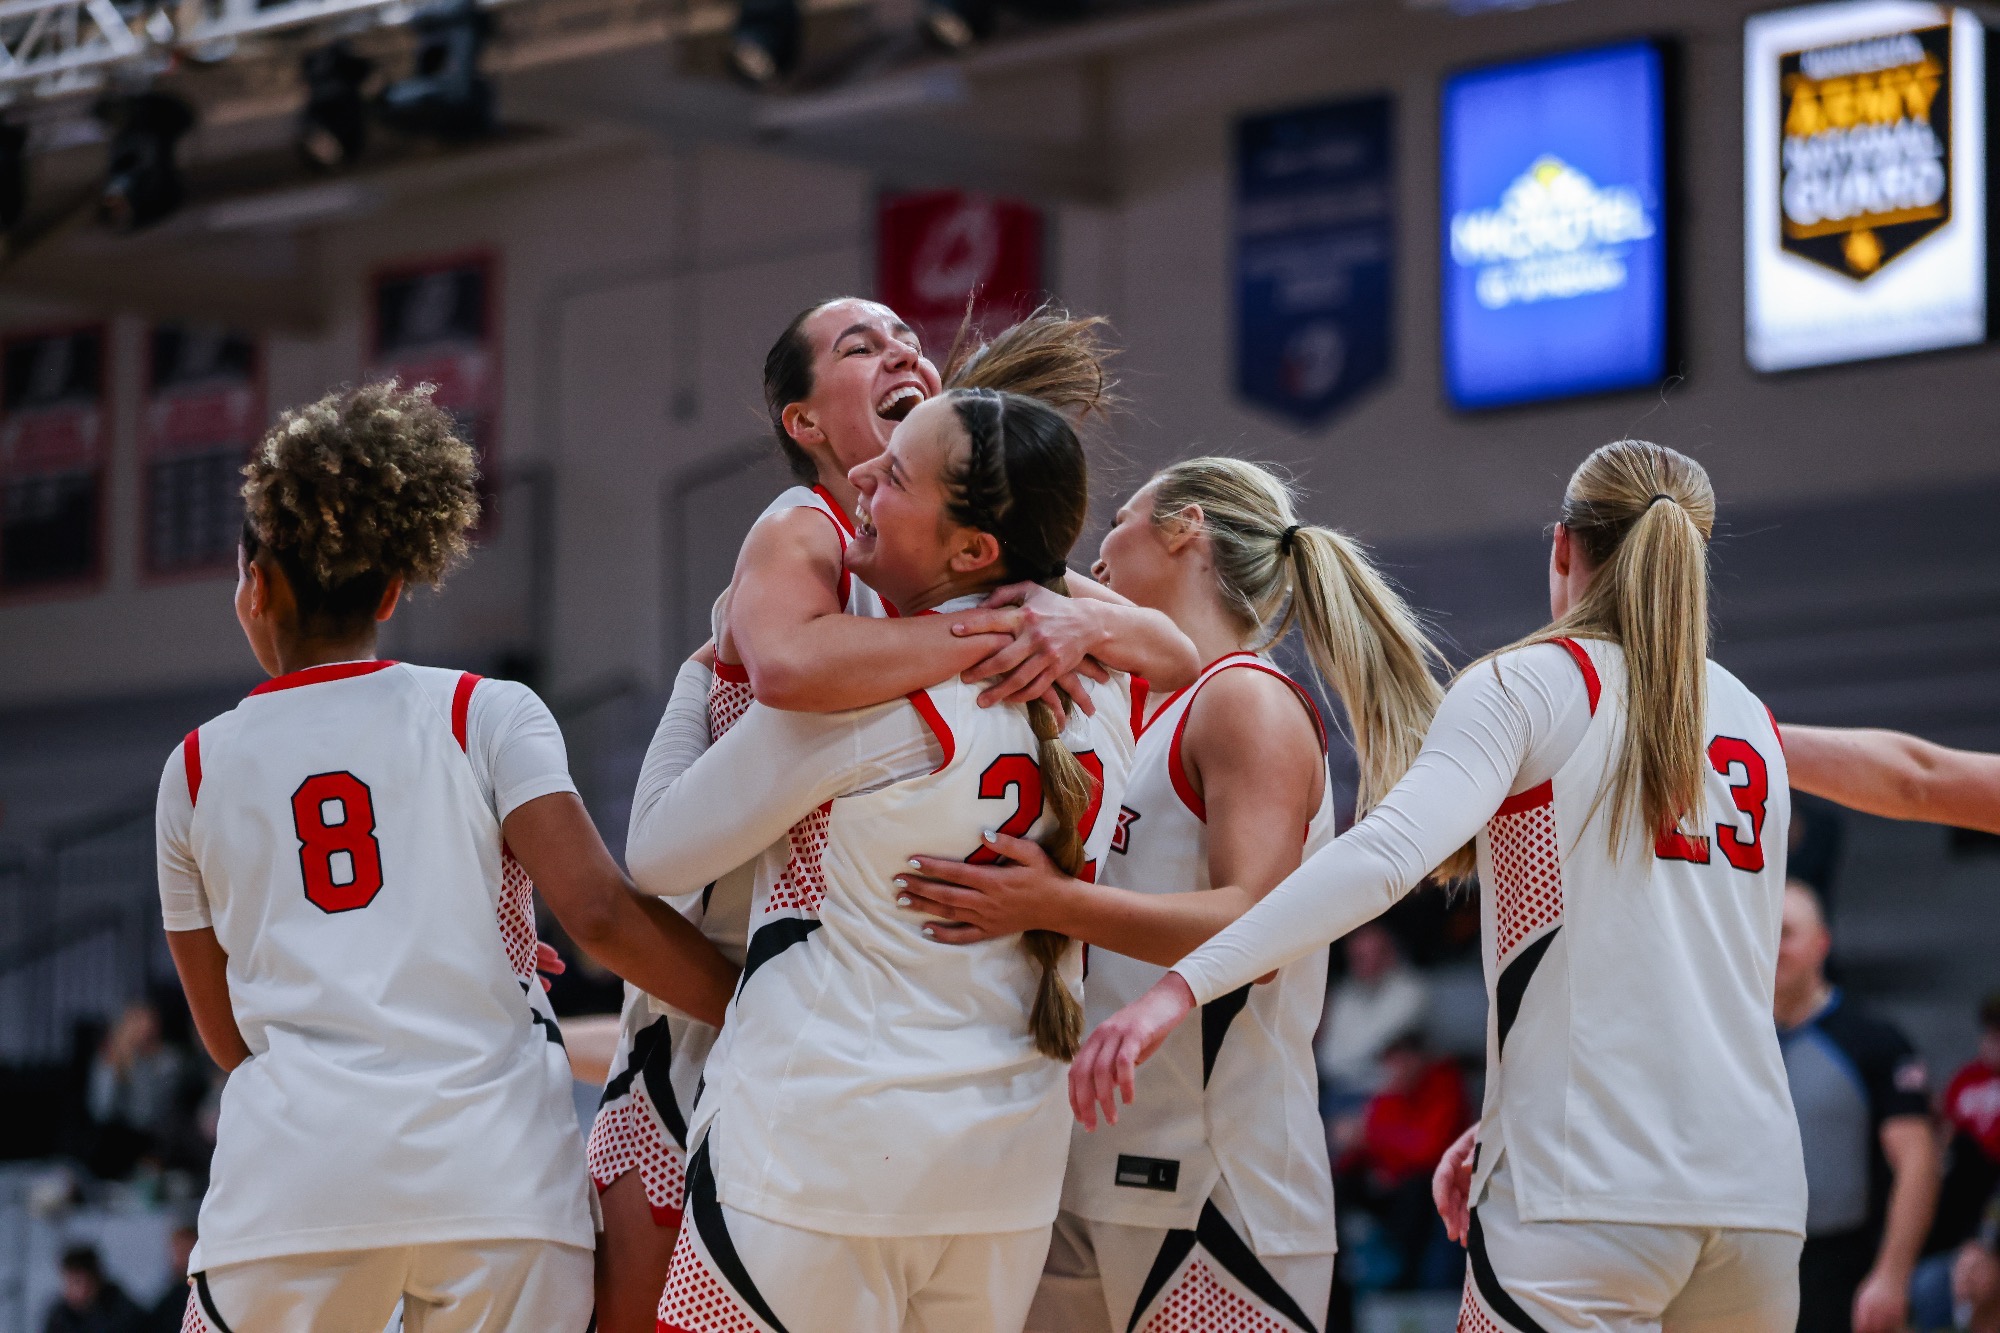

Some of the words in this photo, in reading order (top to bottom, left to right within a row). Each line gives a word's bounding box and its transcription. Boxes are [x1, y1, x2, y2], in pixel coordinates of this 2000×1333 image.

[1782, 53, 1942, 138] ARMY
[1783, 157, 1945, 225] GUARD
[290, 770, 384, 914] 8
